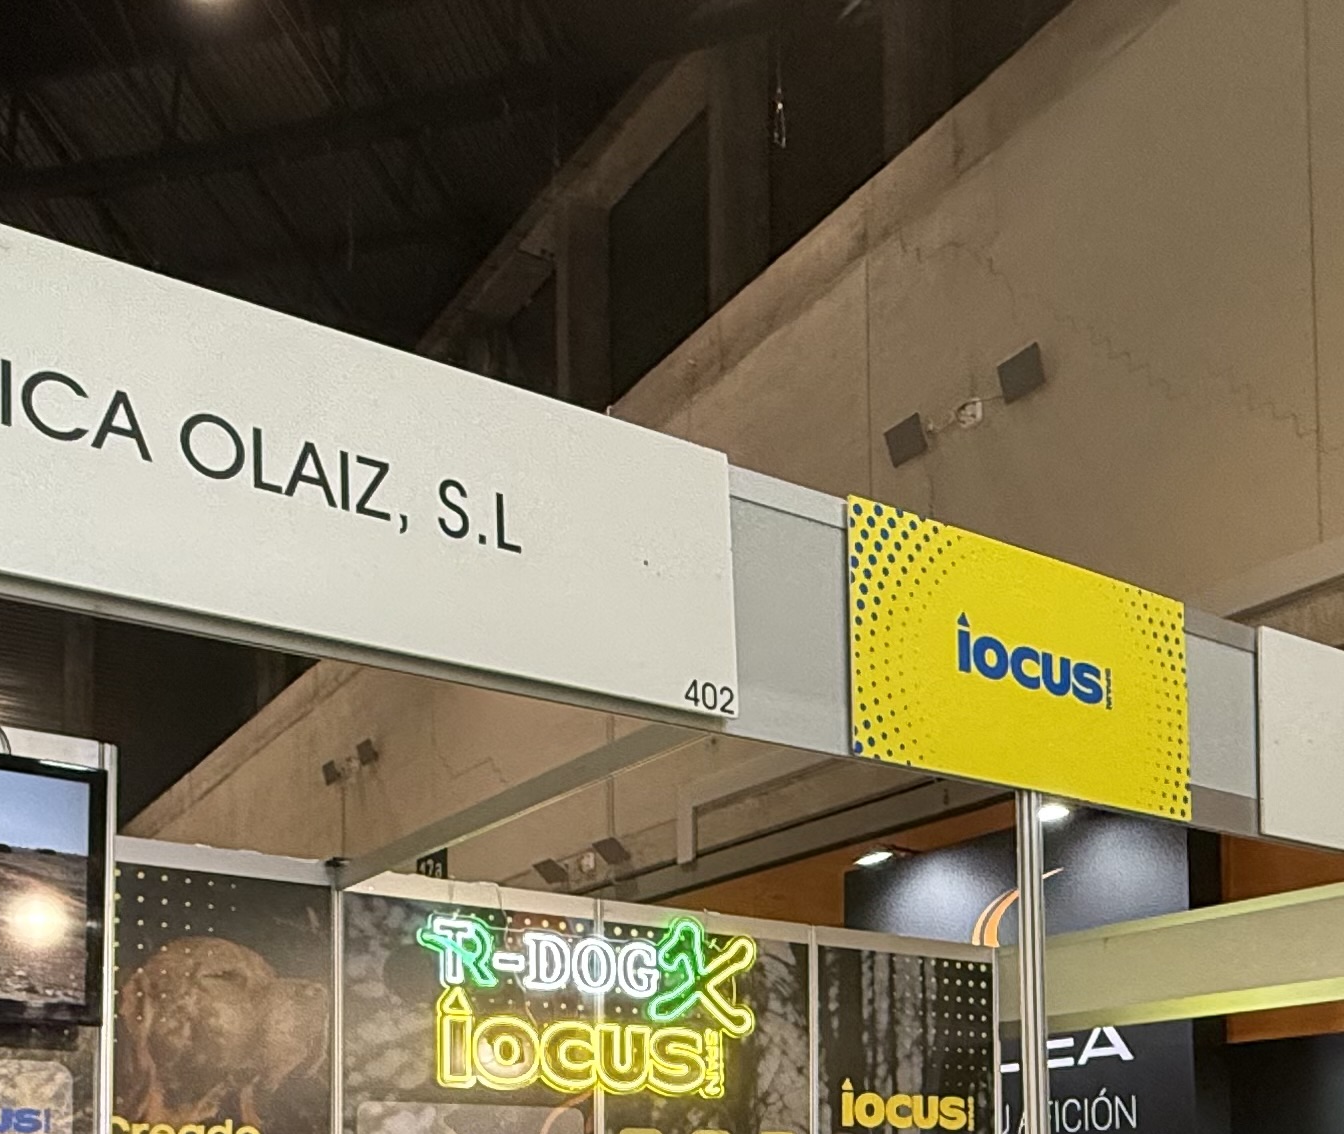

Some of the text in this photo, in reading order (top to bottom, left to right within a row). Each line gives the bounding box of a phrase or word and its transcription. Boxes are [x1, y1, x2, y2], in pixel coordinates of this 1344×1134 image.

[179, 412, 411, 532] OLAIZ,
[438, 478, 523, 553] S.L
[685, 680, 735, 715] 402
